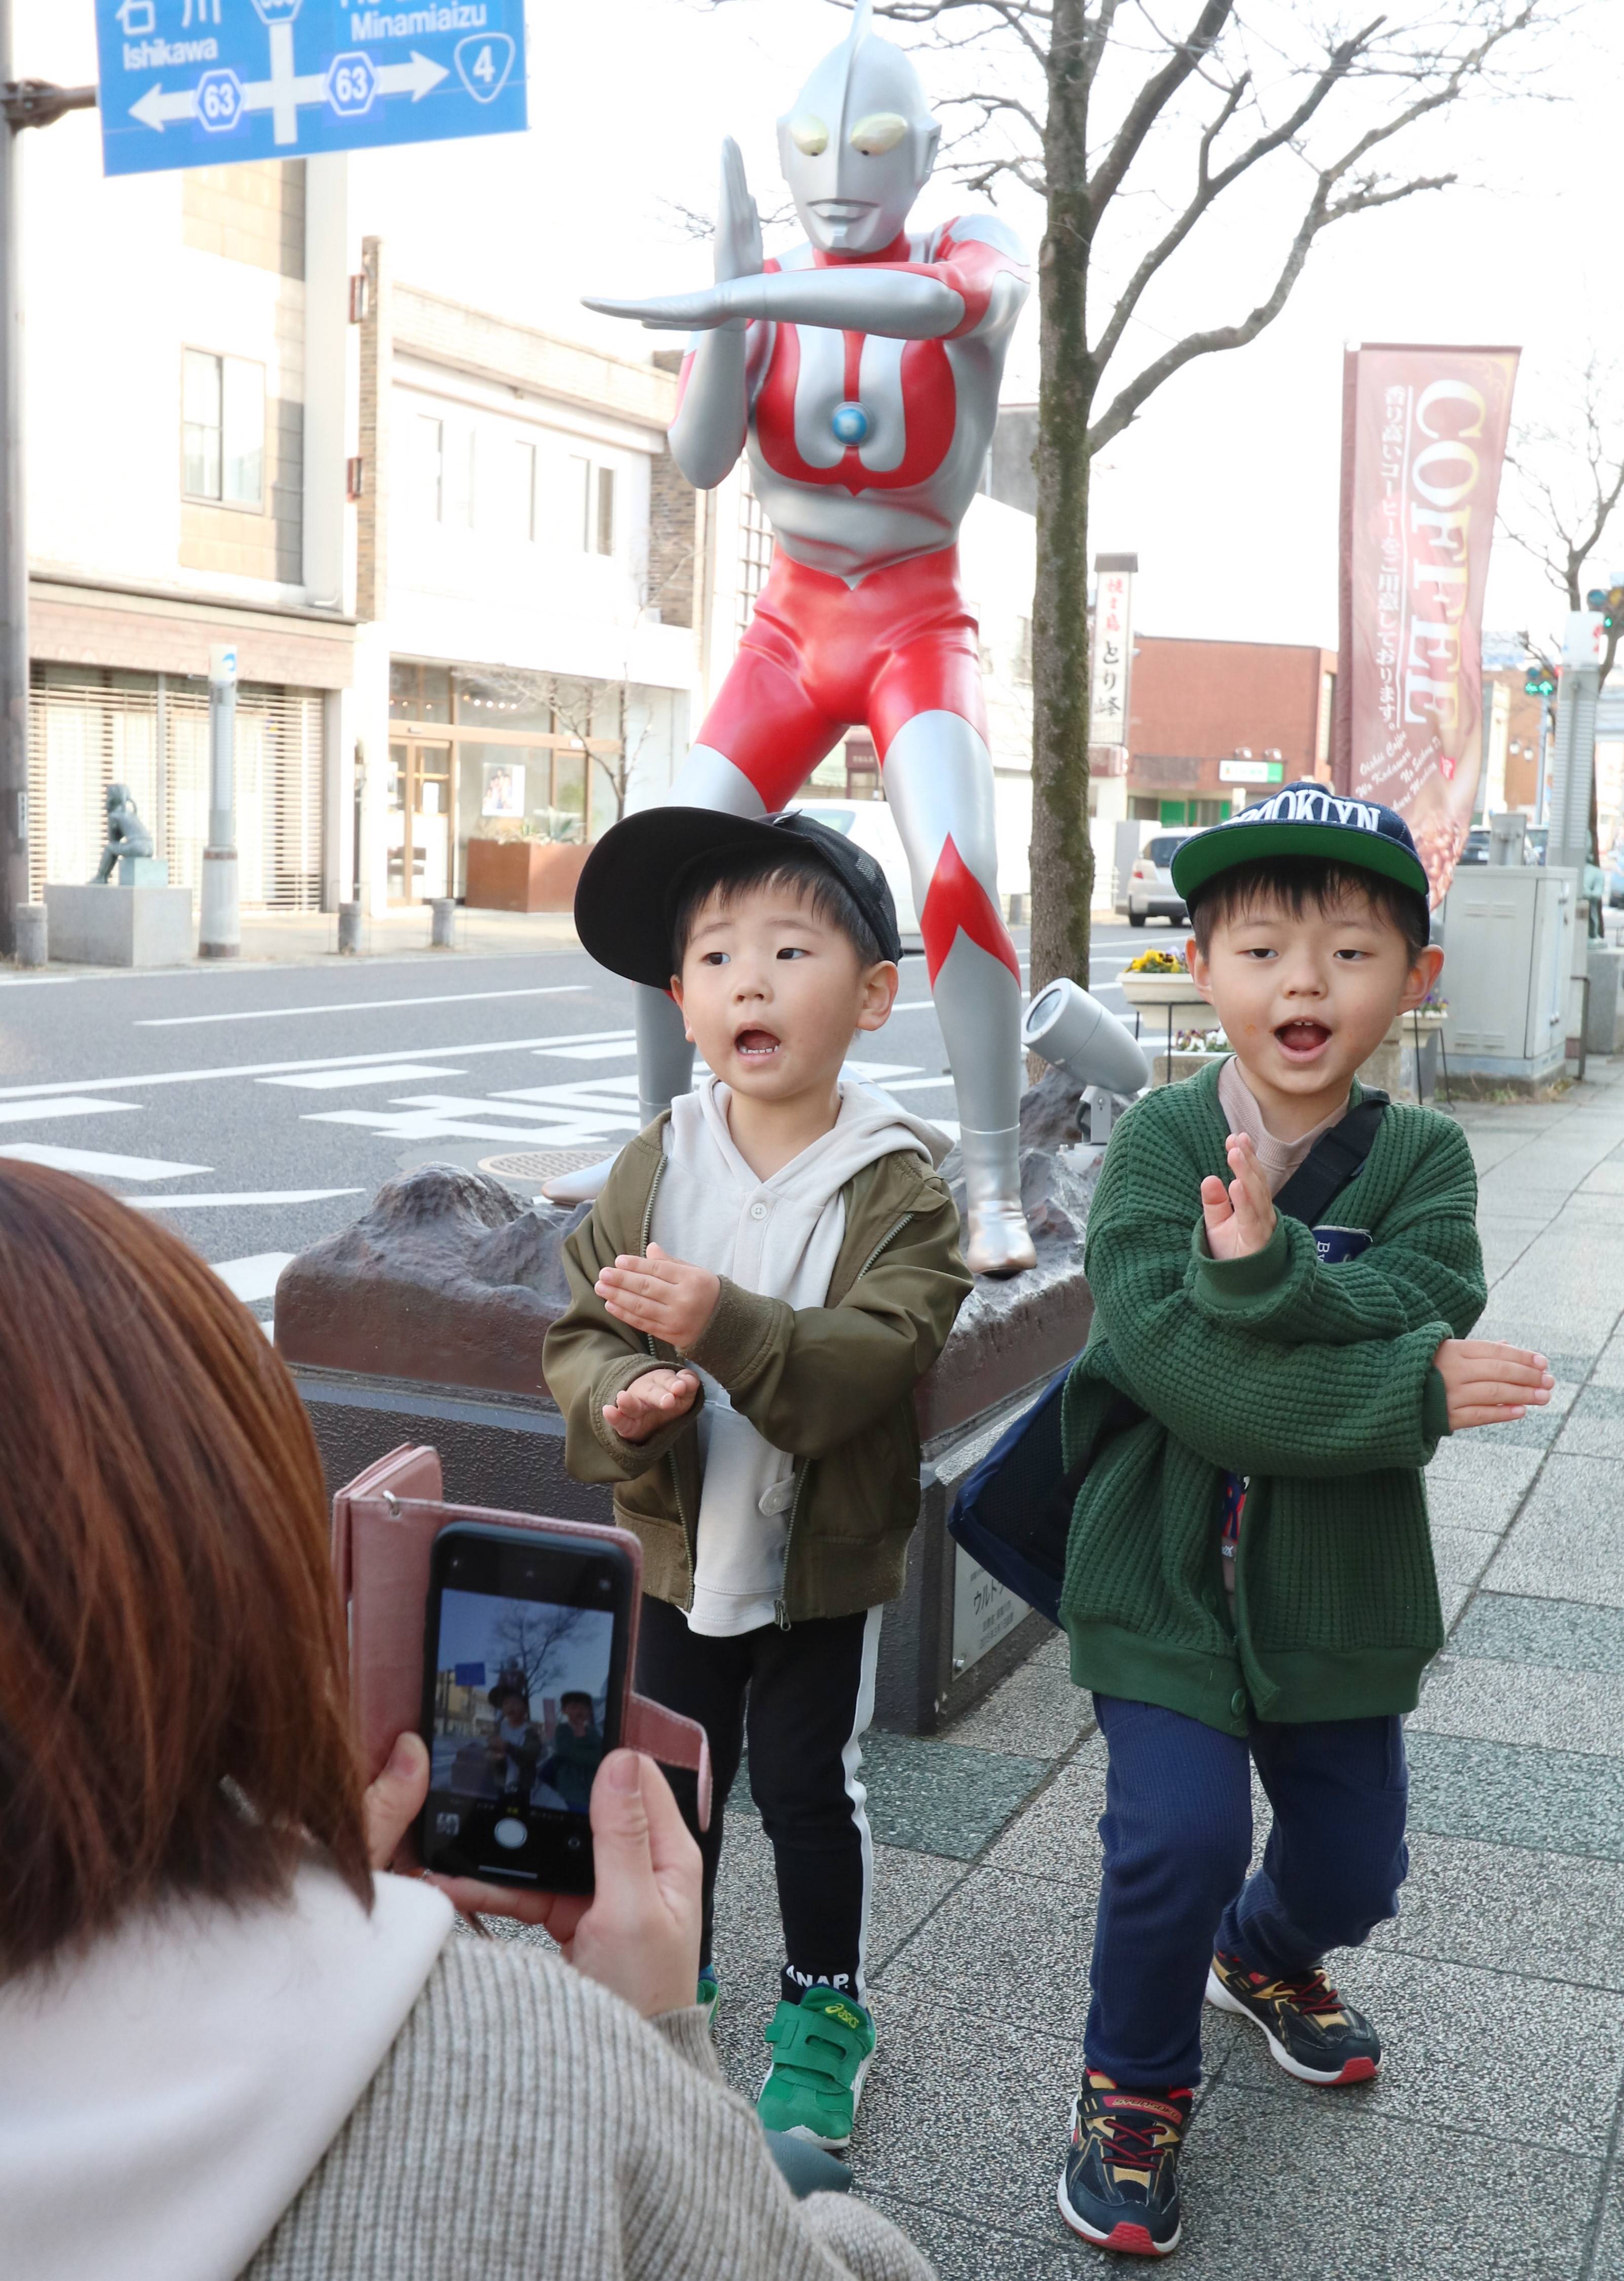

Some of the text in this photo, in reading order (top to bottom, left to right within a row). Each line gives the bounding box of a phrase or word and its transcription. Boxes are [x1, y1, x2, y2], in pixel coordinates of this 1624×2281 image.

[351, 3, 487, 41] Minamiaizu
[123, 38, 218, 70] Ishikawa
[472, 45, 496, 83] 4
[203, 84, 235, 118] 63
[336, 66, 368, 102] 63
[1404, 379, 1486, 730] COFFEE
[1386, 731, 1407, 757] Coffee
[1112, 2098, 1179, 2119] SYUNSOKU
